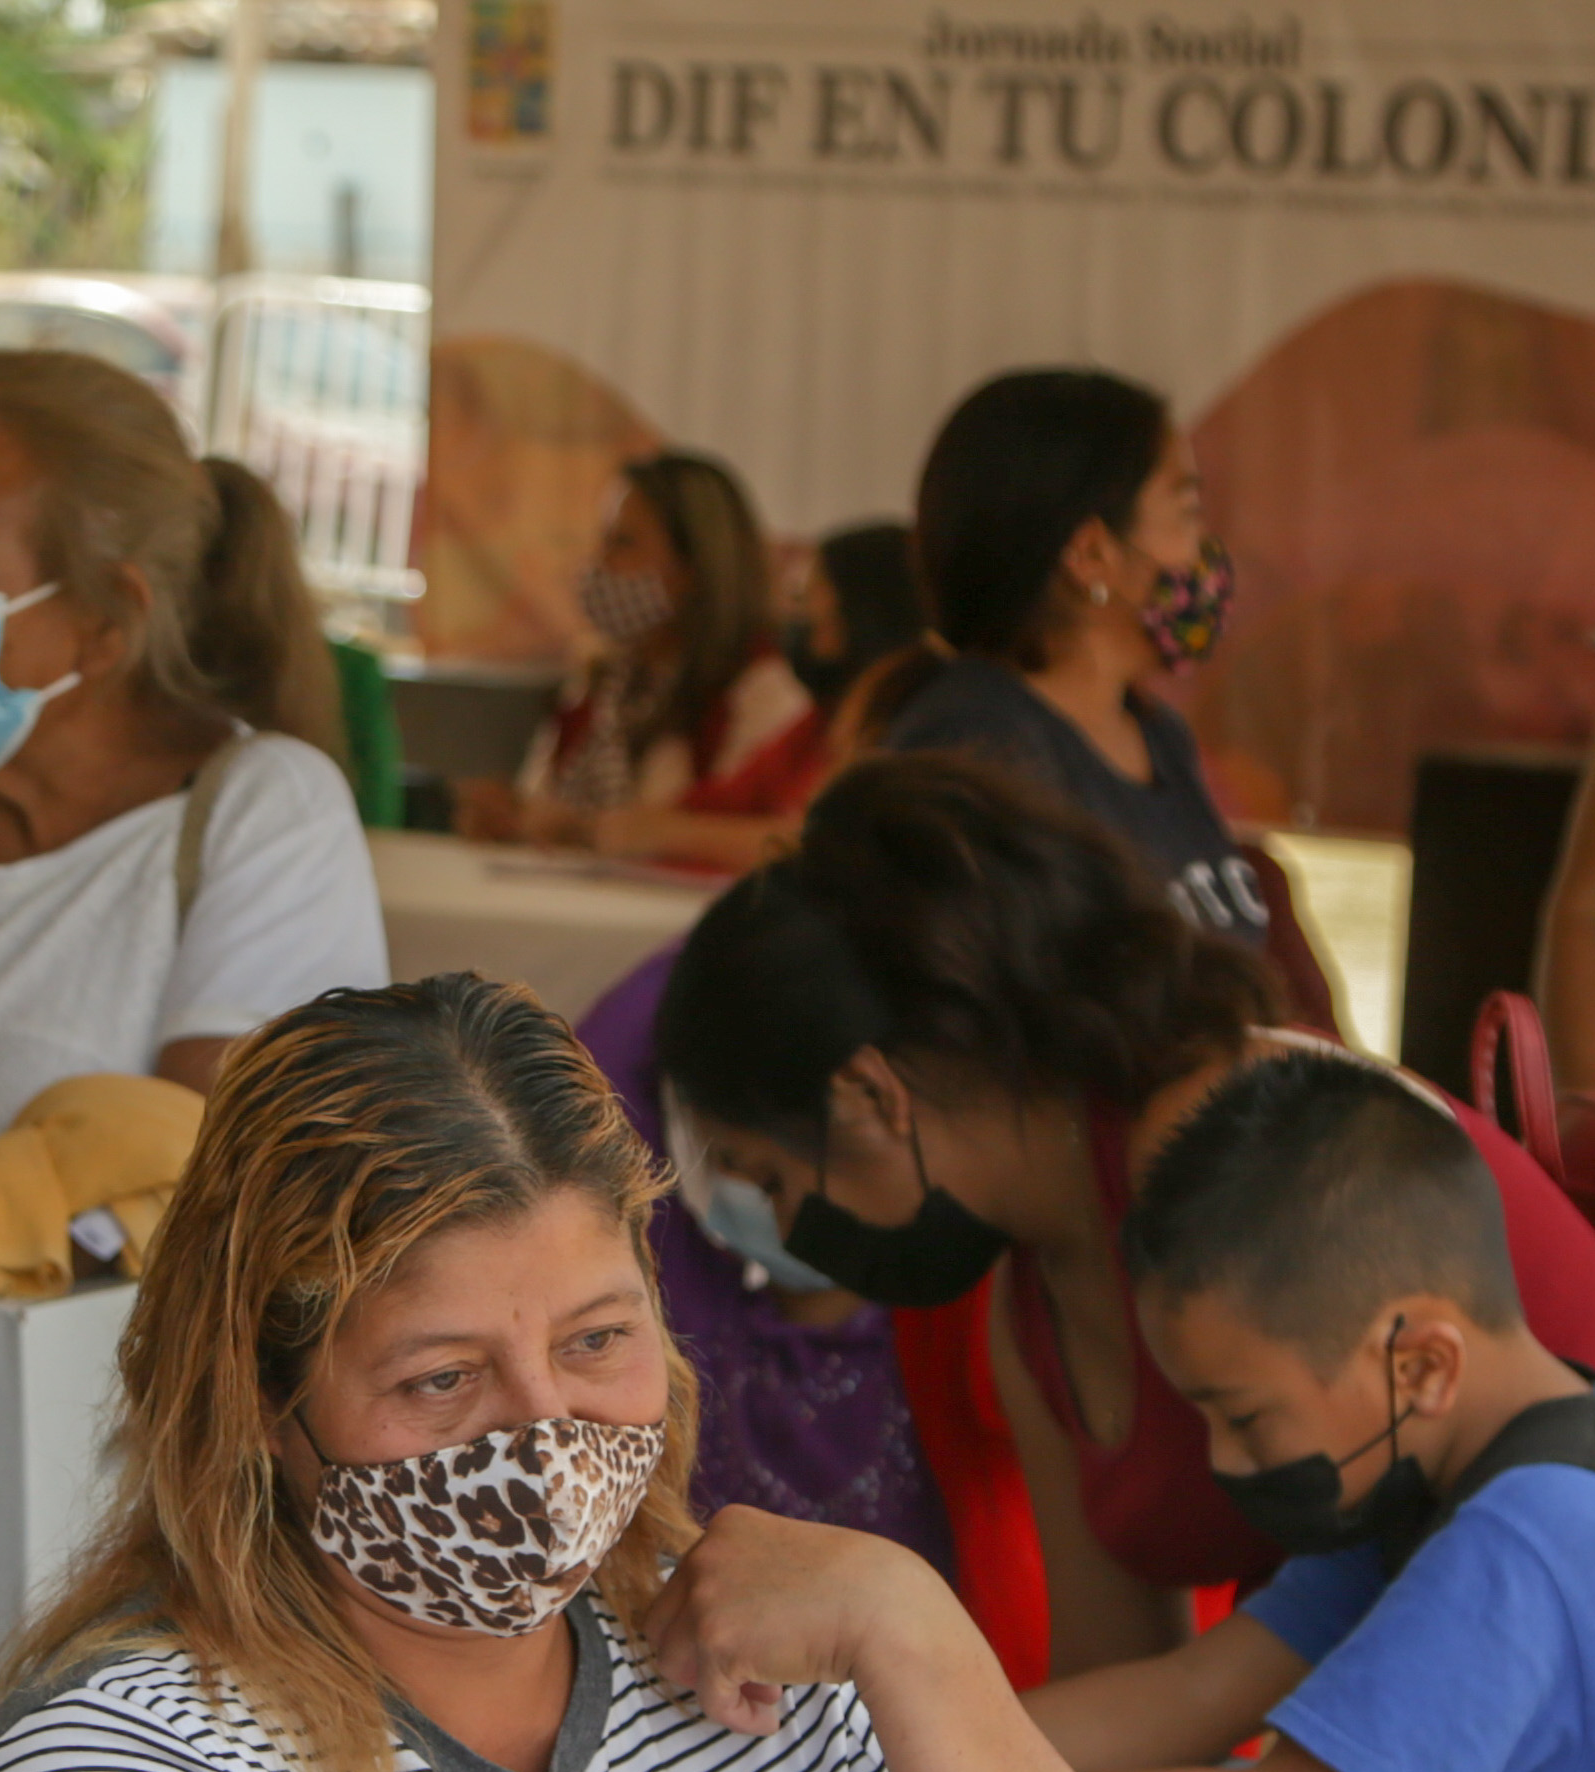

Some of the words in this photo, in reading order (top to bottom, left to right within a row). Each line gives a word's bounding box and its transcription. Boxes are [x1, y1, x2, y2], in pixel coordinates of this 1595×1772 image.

[1146, 8, 1302, 67] Social
[606, 60, 790, 157] DIF
[810, 62, 955, 163] EN
[973, 69, 1132, 172] TU
